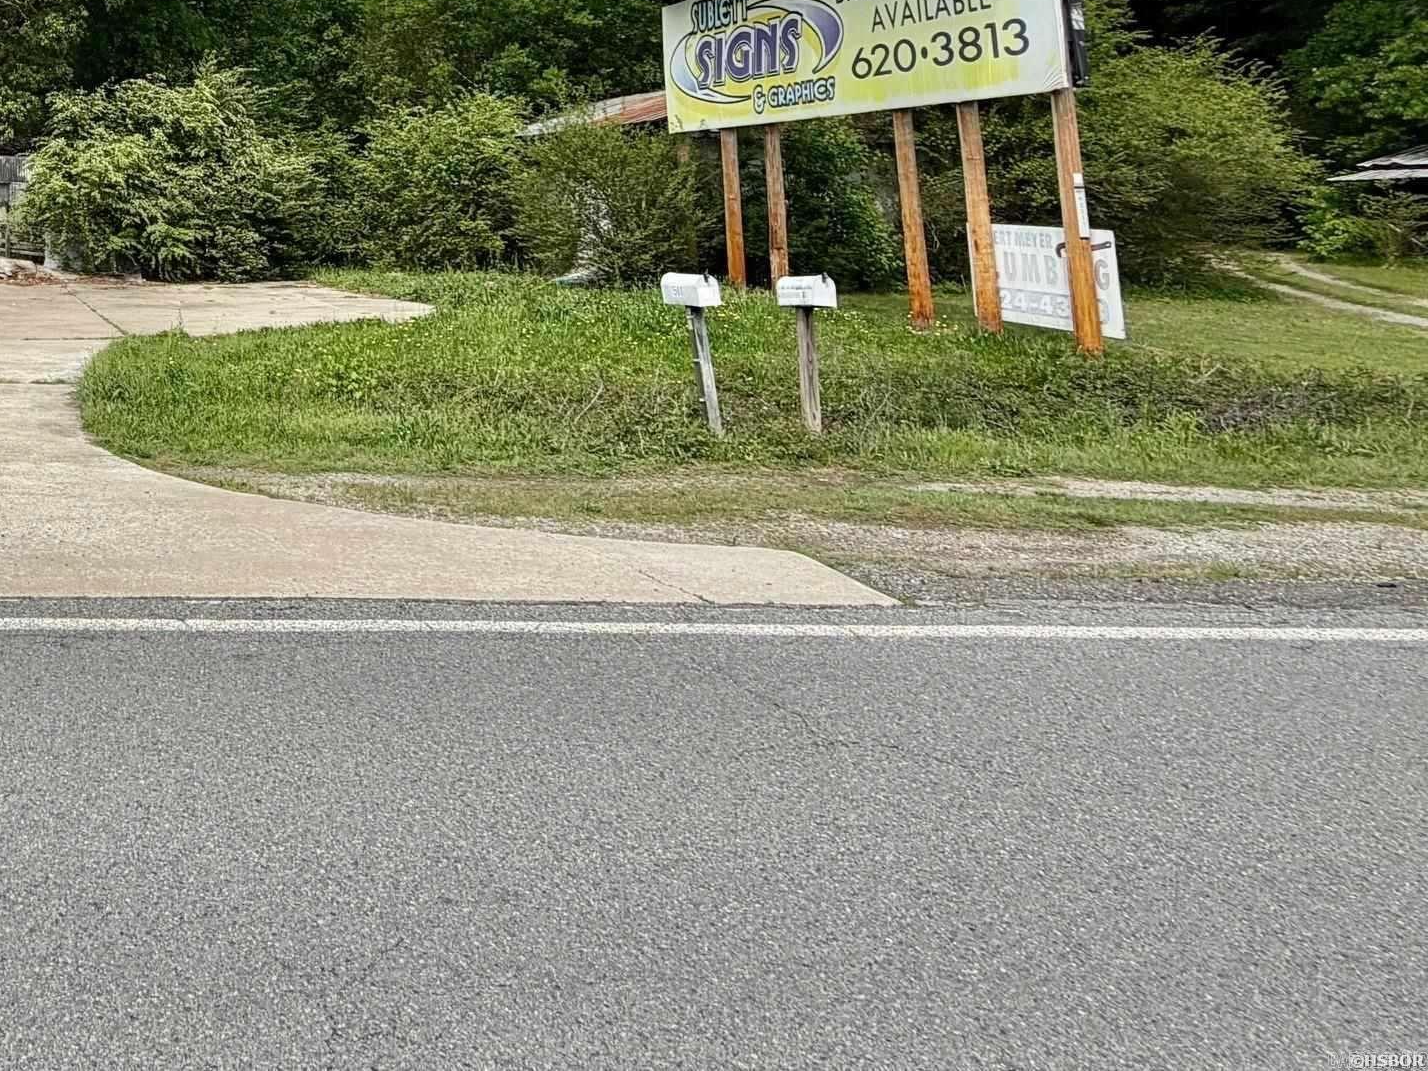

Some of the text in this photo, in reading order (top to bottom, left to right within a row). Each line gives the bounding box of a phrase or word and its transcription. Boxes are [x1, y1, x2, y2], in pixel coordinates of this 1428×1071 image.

[695, 10, 804, 90] SIGNS
[752, 75, 836, 115] & GRAPHICS
